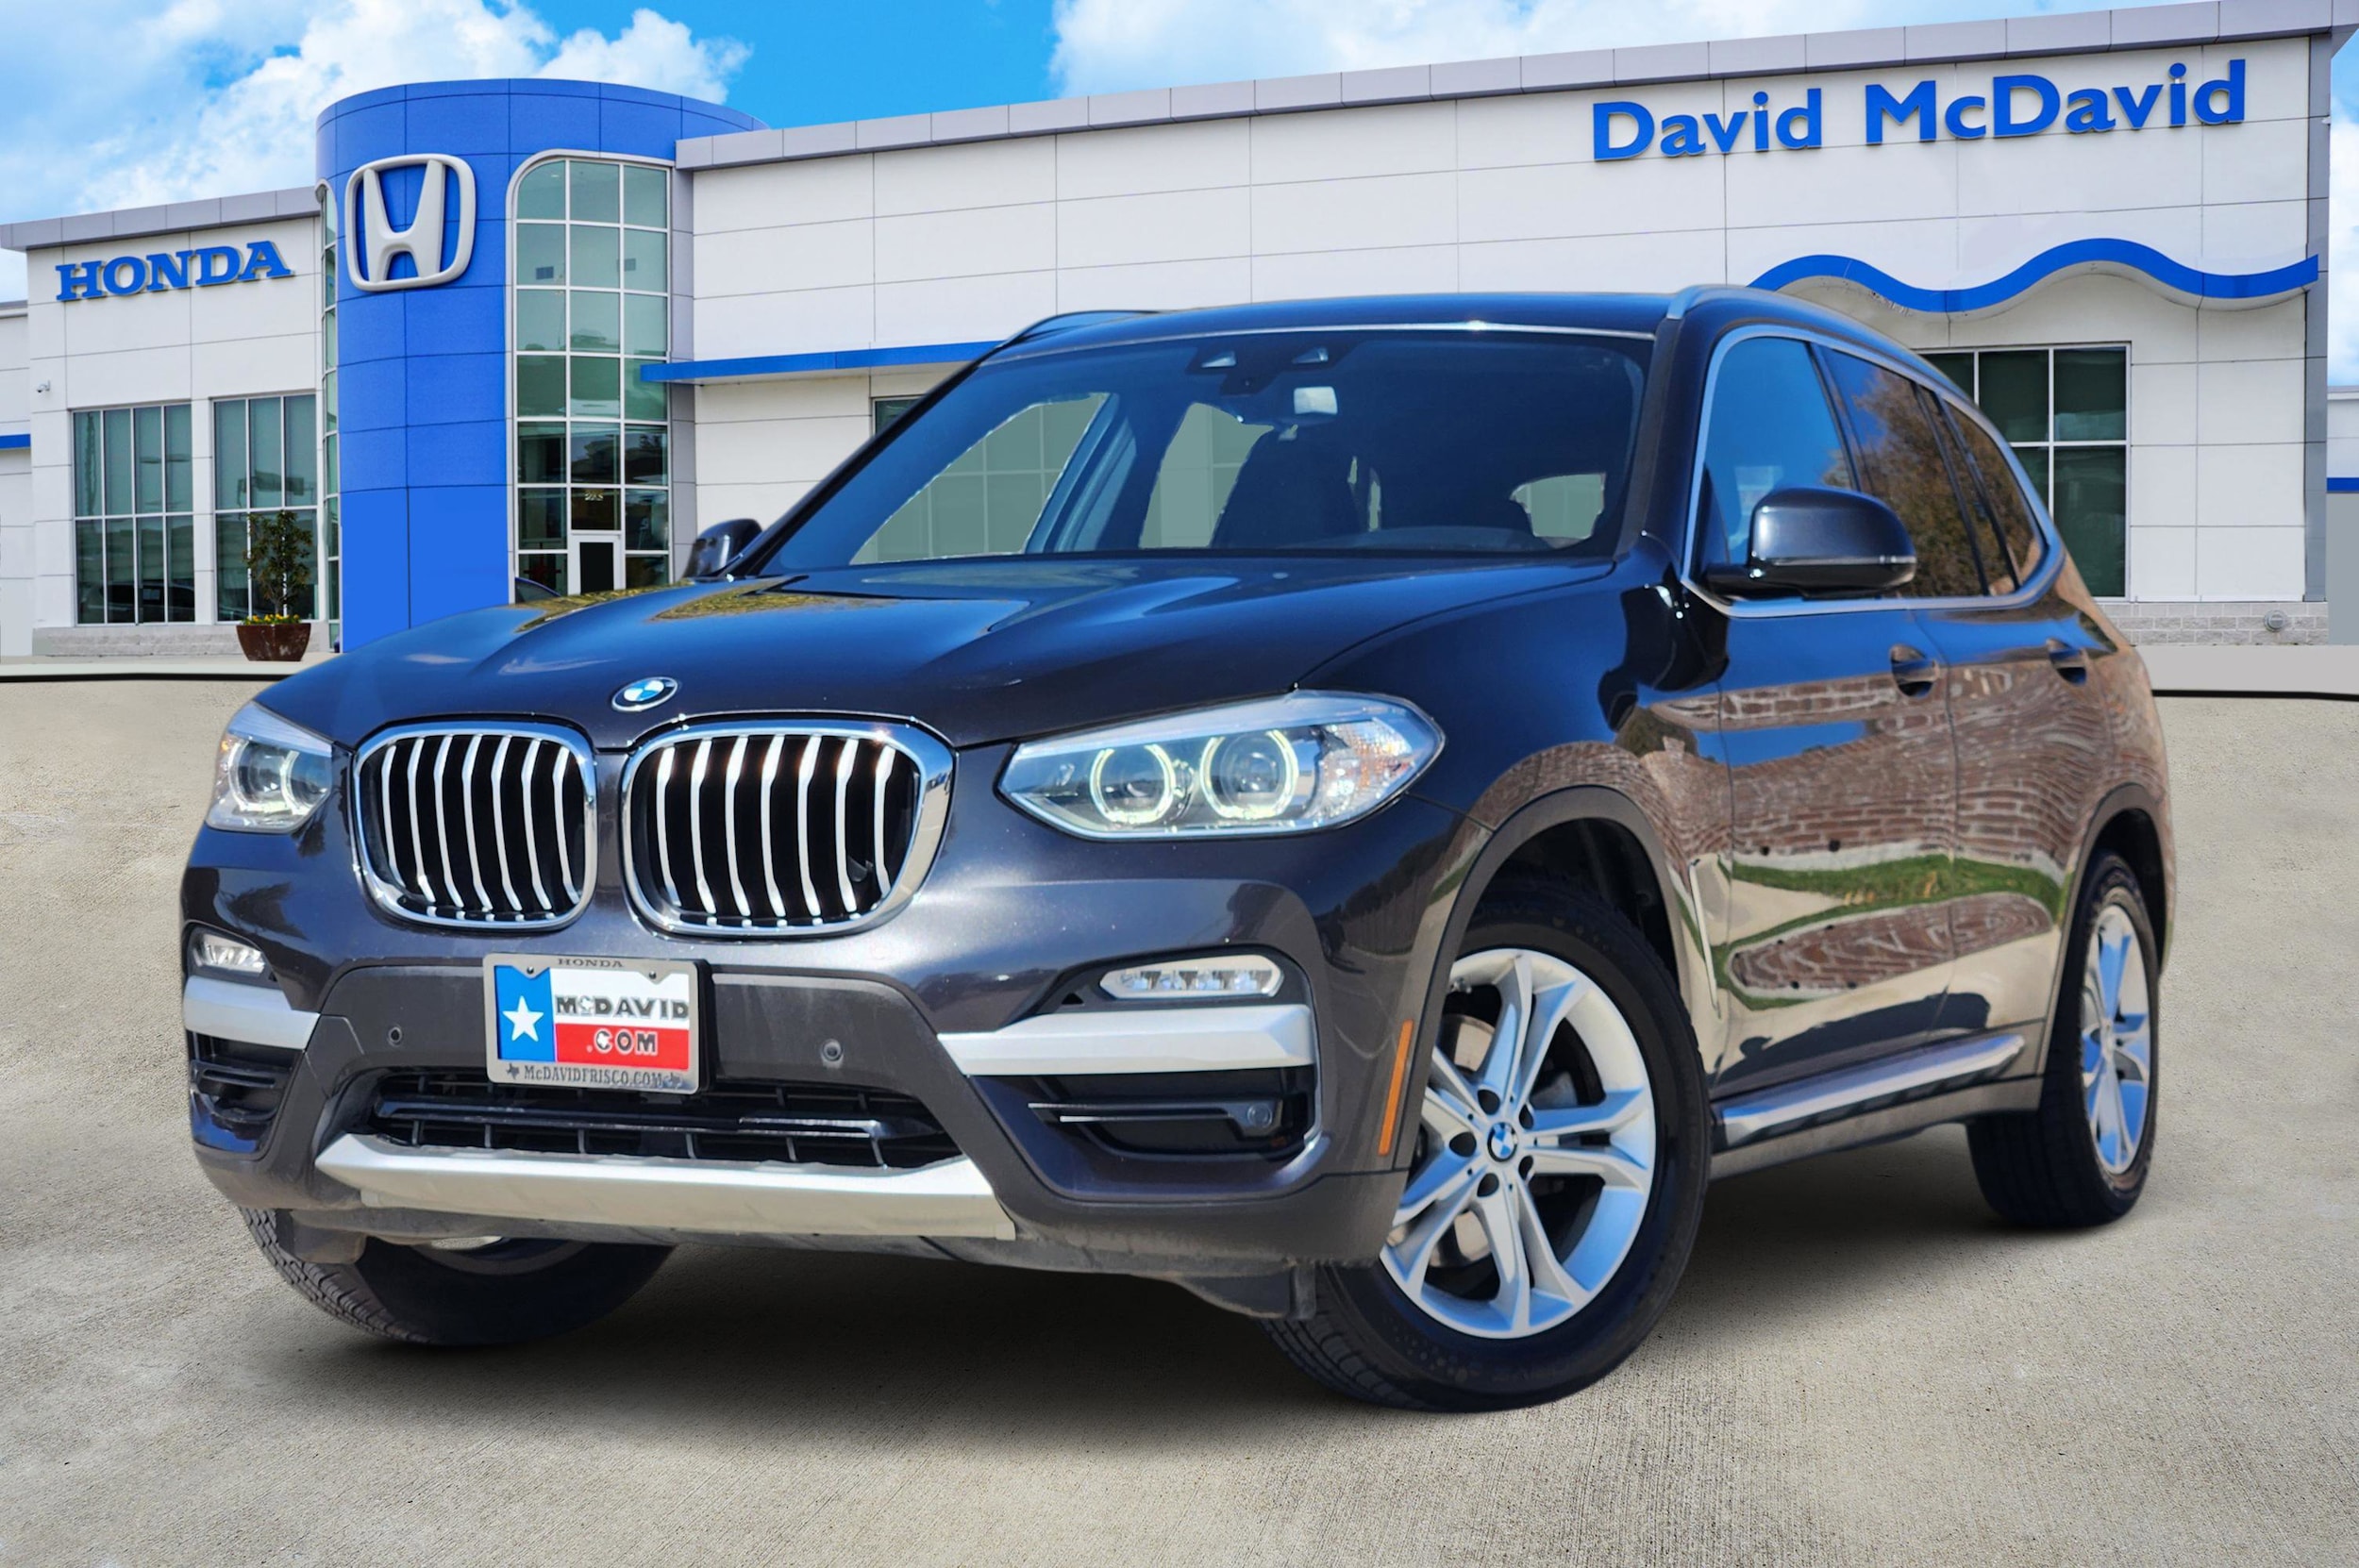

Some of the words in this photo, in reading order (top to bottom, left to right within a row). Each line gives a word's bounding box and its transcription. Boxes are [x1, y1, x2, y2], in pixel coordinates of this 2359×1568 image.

[1593, 88, 1822, 161] David
[1865, 58, 2247, 143] McDavid
[55, 241, 292, 301] HONDA
[558, 958, 624, 968] HONDA
[587, 1028, 658, 1055] .COM
